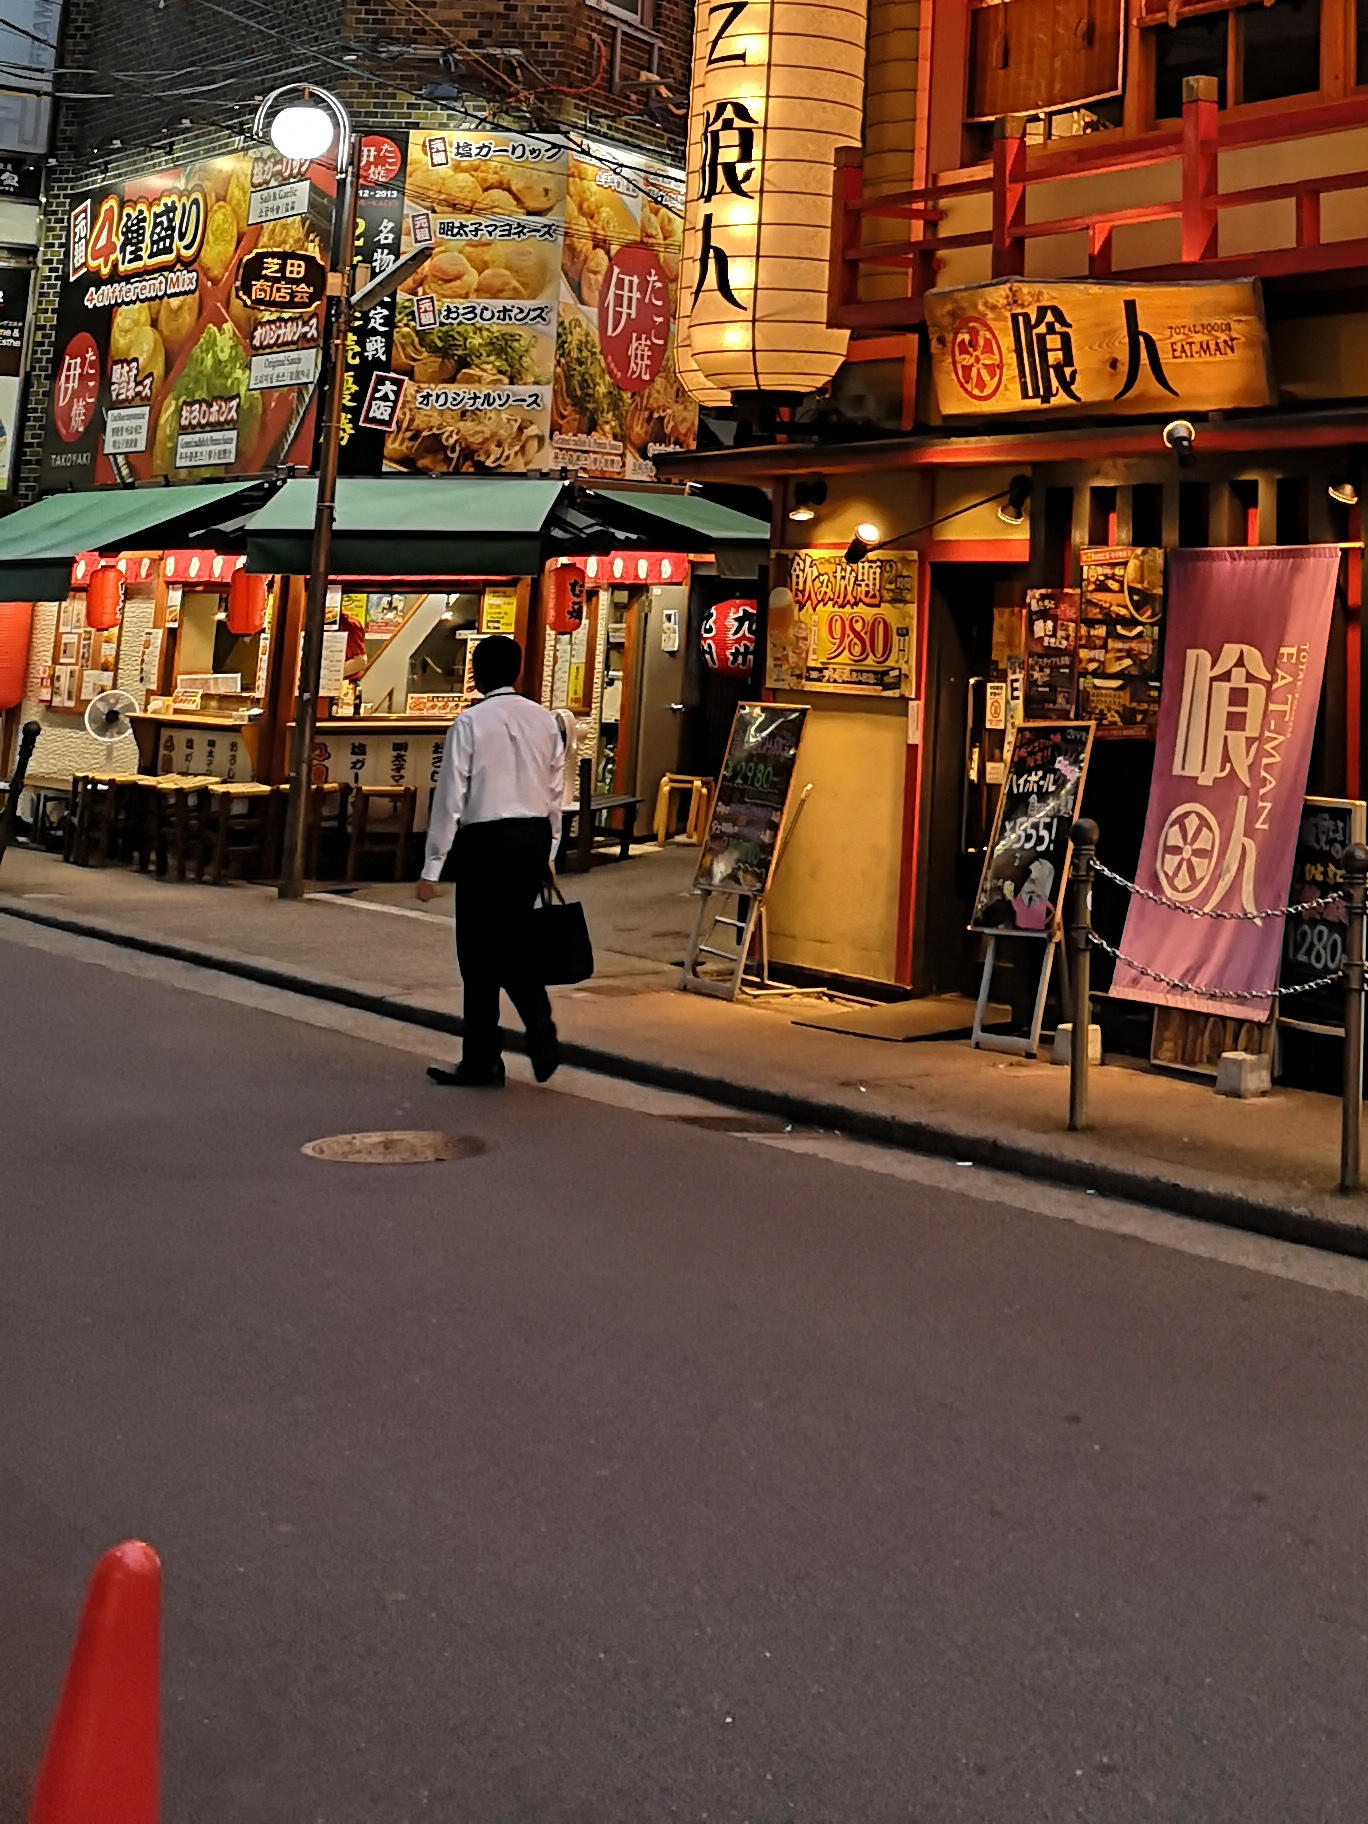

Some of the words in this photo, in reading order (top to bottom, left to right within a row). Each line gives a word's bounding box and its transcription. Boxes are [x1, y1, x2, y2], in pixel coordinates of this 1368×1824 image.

[454, 141, 564, 163] 塩ガーリック
[90, 193, 203, 275] 4種盛り
[437, 220, 556, 240] 明太子マヨネーズ
[261, 257, 306, 278] 芝田
[167, 270, 198, 295] Mix
[251, 279, 314, 303] 商店会
[1171, 336, 1239, 360] EAT-MAN
[368, 379, 399, 422] 大阪
[416, 390, 543, 411] オリジナルソース
[51, 452, 92, 467] TAKOYAKI
[790, 553, 882, 612] 飲み放題
[826, 612, 893, 664] 980
[1254, 644, 1298, 831] EAT-MAN
